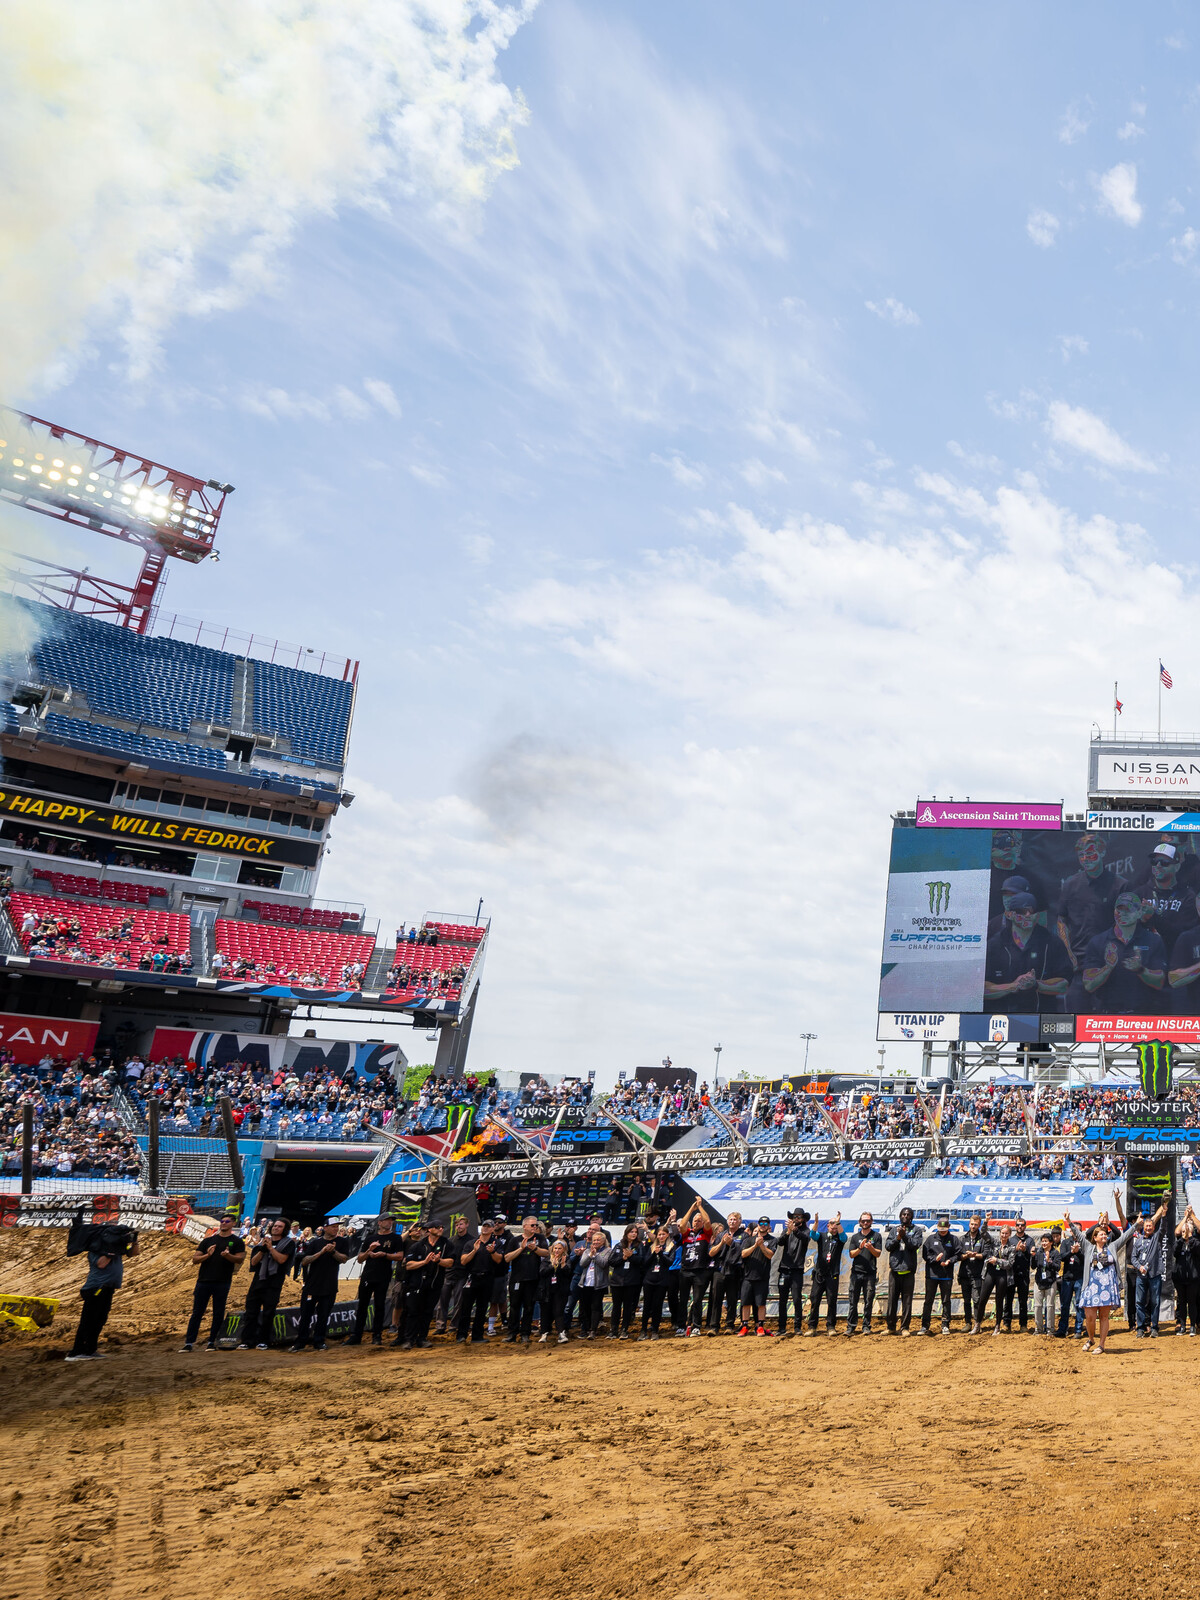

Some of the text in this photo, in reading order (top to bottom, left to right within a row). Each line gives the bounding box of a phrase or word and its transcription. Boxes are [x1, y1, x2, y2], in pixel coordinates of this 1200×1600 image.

[1128, 776, 1189, 785] STADIUM
[939, 810, 1060, 822] Ascension Saint Thomas
[1088, 813, 1155, 829] Pinnacle
[9, 795, 95, 824] HAPPY
[111, 815, 180, 840] WILLS
[181, 827, 275, 856] FEDRICK
[889, 933, 982, 943] SUPERCROSS
[894, 1014, 945, 1026] TITAN UP
[991, 1018, 1008, 1030] Lite
[1085, 1018, 1114, 1029] Farm
[1115, 1019, 1154, 1030] Bureau
[923, 1029, 938, 1038] Lite
[1115, 1101, 1193, 1114] MONSTER
[1089, 1119, 1105, 1127] AMA
[789, 1145, 829, 1153] MOUNTAIN
[862, 1141, 926, 1150] ROCKY MOUNTAIN
[1124, 1141, 1190, 1153] Championship
[665, 1150, 729, 1160] ROCKY MOUNTAIN
[561, 1156, 626, 1167] ROCKY MOUNTAIN
[465, 1162, 530, 1174] ROCKY MOUNTAIN
